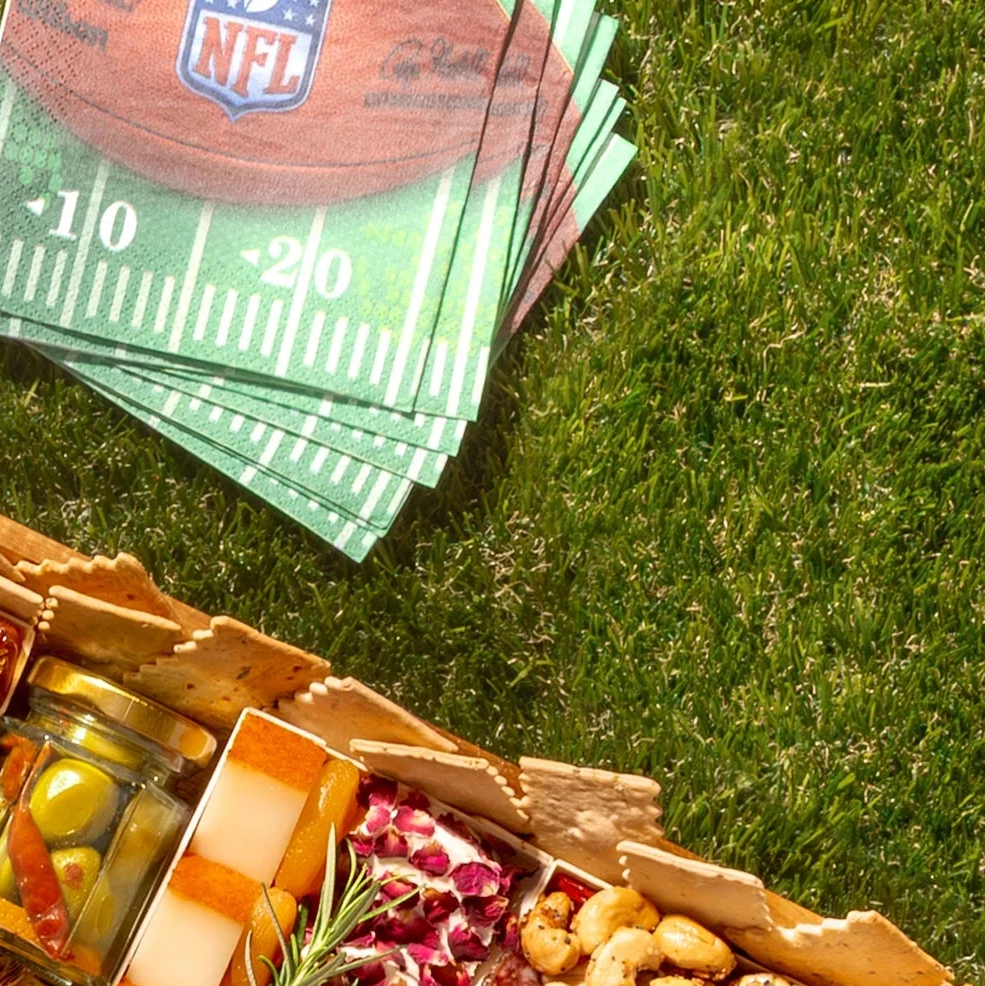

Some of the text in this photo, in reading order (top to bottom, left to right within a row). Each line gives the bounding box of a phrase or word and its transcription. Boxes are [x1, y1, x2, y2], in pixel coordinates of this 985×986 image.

[192, 16, 300, 98] NFL
[49, 190, 138, 251] 10
[260, 236, 352, 299] 20
